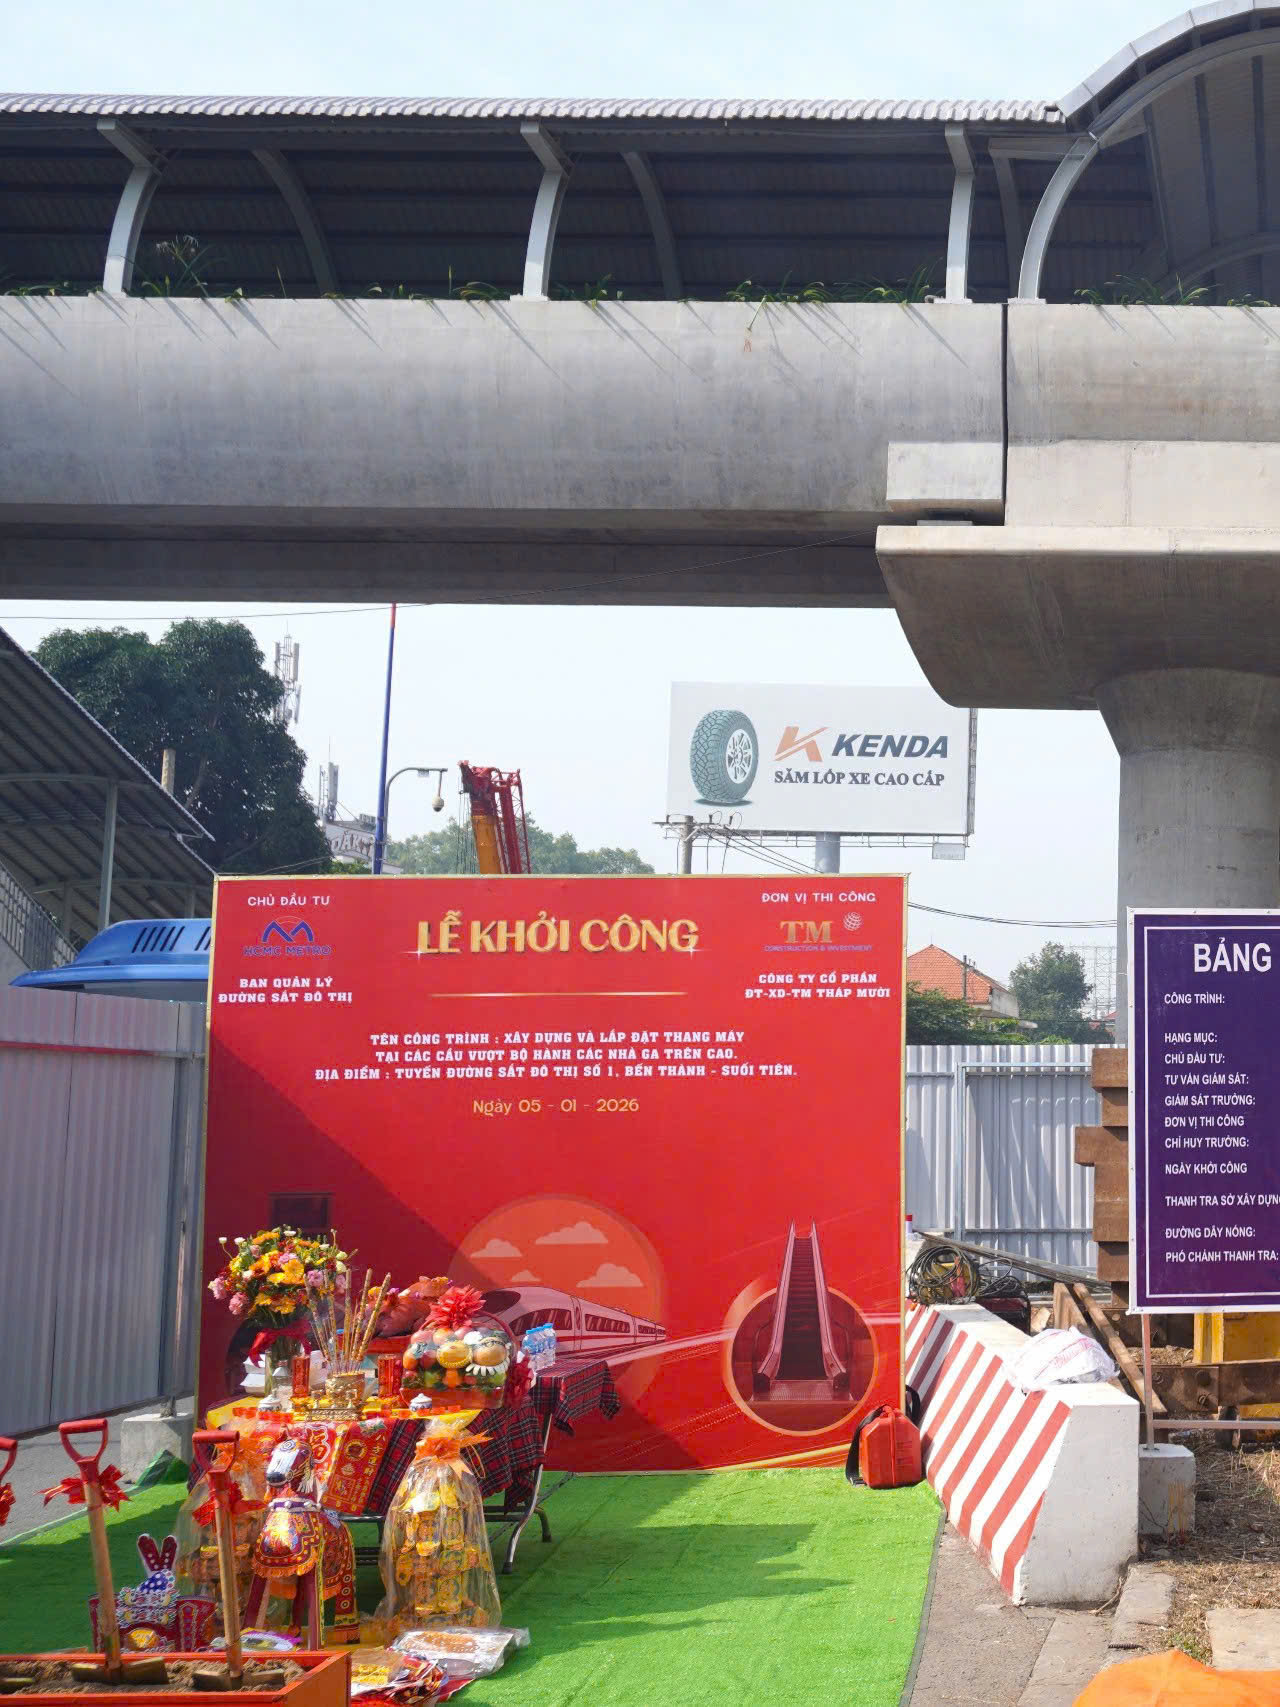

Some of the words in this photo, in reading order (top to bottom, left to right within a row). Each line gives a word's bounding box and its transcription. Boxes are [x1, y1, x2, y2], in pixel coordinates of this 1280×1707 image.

[831, 733, 948, 758] KENDA
[774, 768, 809, 784] SĂM
[848, 772, 871, 785] XE
[874, 773, 909, 786] CAO
[247, 893, 275, 906] CHỦ
[280, 892, 307, 906] ĐẦU
[313, 895, 330, 906] TƯ
[761, 892, 789, 902] ĐƠN
[795, 893, 807, 904] VỊ
[812, 892, 833, 902] THI
[838, 890, 877, 902] CÔNG
[417, 909, 462, 953] LỄ
[470, 910, 571, 953] KHỞI
[579, 914, 700, 953] CÔNG
[780, 919, 833, 944] TM
[243, 945, 282, 958] HCMC
[285, 944, 332, 957] METRO
[1193, 937, 1272, 972] BẢNG
[239, 977, 268, 988] BAN
[273, 976, 311, 989] QUẢN
[315, 976, 333, 988] LÝ
[758, 972, 794, 984] CÔNG
[798, 973, 816, 984] TY
[218, 991, 266, 1003] ĐƯỜNG
[304, 991, 323, 1002] ĐÔ
[328, 992, 353, 1004] THỊ
[745, 988, 812, 999] ĐT-XD-TM
[816, 987, 852, 998] THÁP
[857, 986, 891, 998] MƯỜI
[1164, 992, 1192, 1004] CÔNG
[1194, 992, 1225, 1003] TRÌNH:
[370, 1033, 398, 1045] TÊN
[403, 1032, 440, 1045] CÔNG
[445, 1032, 489, 1044] TRÌNH
[504, 1031, 530, 1044] XÂY
[535, 1032, 572, 1045] DỰNG
[577, 1030, 595, 1042] VÀ
[664, 1031, 710, 1043] THANG
[715, 1029, 745, 1042] MÁY
[1164, 1033, 1192, 1045] HẠNG
[1193, 1032, 1218, 1045] MỤC:
[375, 1051, 400, 1064] TẠI
[404, 1049, 431, 1062] CÁC
[468, 1050, 505, 1063] VƯỢT
[510, 1048, 528, 1062] BỘ
[533, 1048, 571, 1060] HÀNH
[576, 1047, 603, 1059] CÁC
[608, 1046, 637, 1059] NHÀ
[641, 1048, 660, 1059] GA
[664, 1047, 702, 1059] TRÊN
[707, 1048, 738, 1059] CAO.
[1164, 1052, 1185, 1064] CHỦ
[1208, 1053, 1225, 1063] TƯ:
[315, 1069, 340, 1082] ĐỊA
[446, 1066, 493, 1078] ĐƯỜNG
[530, 1065, 548, 1078] ĐÔ
[553, 1066, 578, 1080] THỊ
[583, 1062, 601, 1077] SỐ
[625, 1063, 653, 1077] BẾN
[658, 1064, 706, 1076] THÀNH
[721, 1062, 754, 1076] SUỐI
[1165, 1075, 1179, 1085] TƯ
[1202, 1072, 1226, 1084] GIÁM
[1228, 1072, 1249, 1084] SÁT:
[1164, 1094, 1189, 1106] GIÁM
[1190, 1093, 1209, 1105] SÁT
[472, 1098, 512, 1117] Ngày
[518, 1099, 542, 1113] 05
[560, 1099, 577, 1112] 01
[596, 1098, 639, 1112] 2026
[1164, 1117, 1186, 1127] ĐƠN
[1188, 1117, 1198, 1129] VỊ
[1200, 1116, 1215, 1126] THI
[1216, 1114, 1245, 1126] CÔNG
[1164, 1136, 1182, 1148] CHỈ
[1183, 1138, 1203, 1148] HUY
[1165, 1162, 1191, 1174] NGÀY
[1219, 1161, 1248, 1173] CÔNG
[1165, 1196, 1197, 1206] THANH
[1199, 1196, 1219, 1206] TRA
[1237, 1193, 1256, 1205] XÂY
[1165, 1226, 1201, 1238] ĐƯỜNG
[1203, 1225, 1223, 1238] DÂY
[1225, 1225, 1256, 1237] NÓNG:
[1165, 1250, 1186, 1262] PHÓ
[1188, 1249, 1221, 1262] CHÁNH
[1224, 1251, 1256, 1261] THANH
[1257, 1250, 1279, 1260] TRA:
